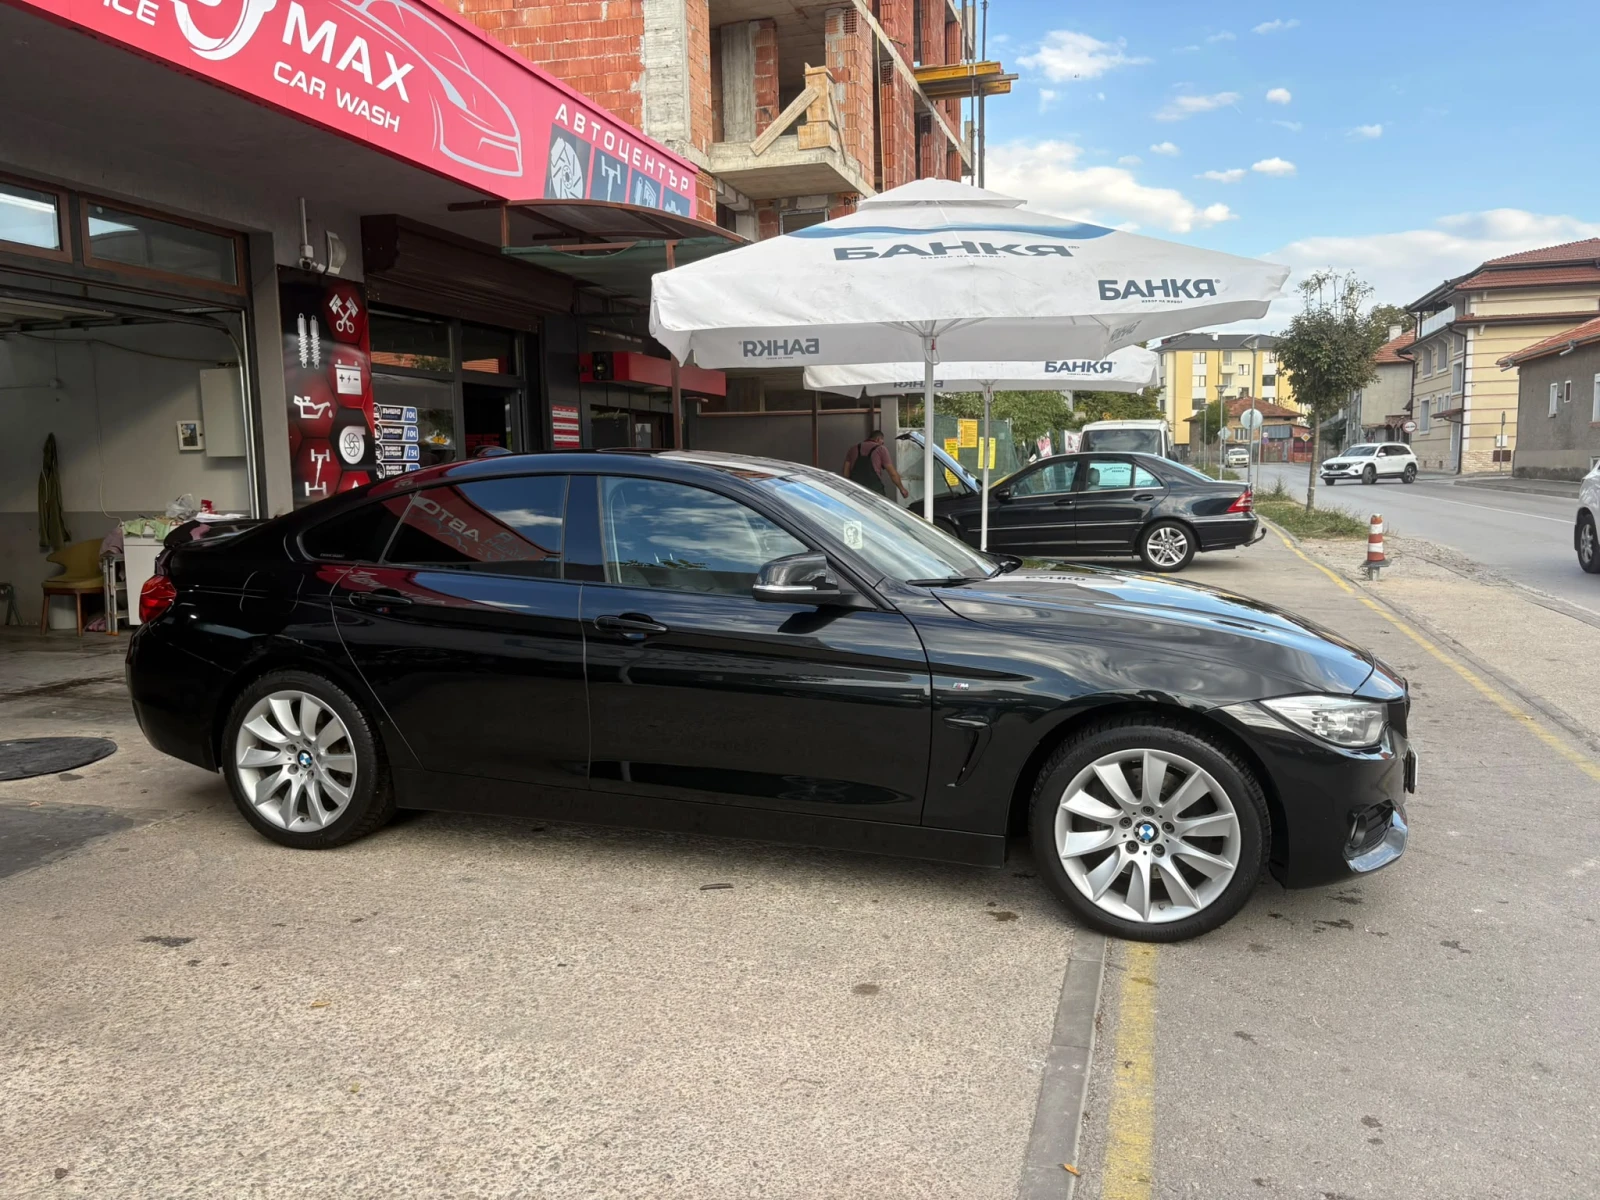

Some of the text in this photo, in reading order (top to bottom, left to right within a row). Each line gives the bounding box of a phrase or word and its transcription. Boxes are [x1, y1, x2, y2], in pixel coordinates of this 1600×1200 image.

[281, 1, 415, 103] MAX
[273, 61, 401, 133] CAR WASH
[555, 103, 689, 192] АВТОЦЕНТЪР
[833, 241, 1074, 261] БАНКЯ
[1098, 279, 1217, 301] БАНКЯ
[1044, 361, 1113, 374] БАНКЯ
